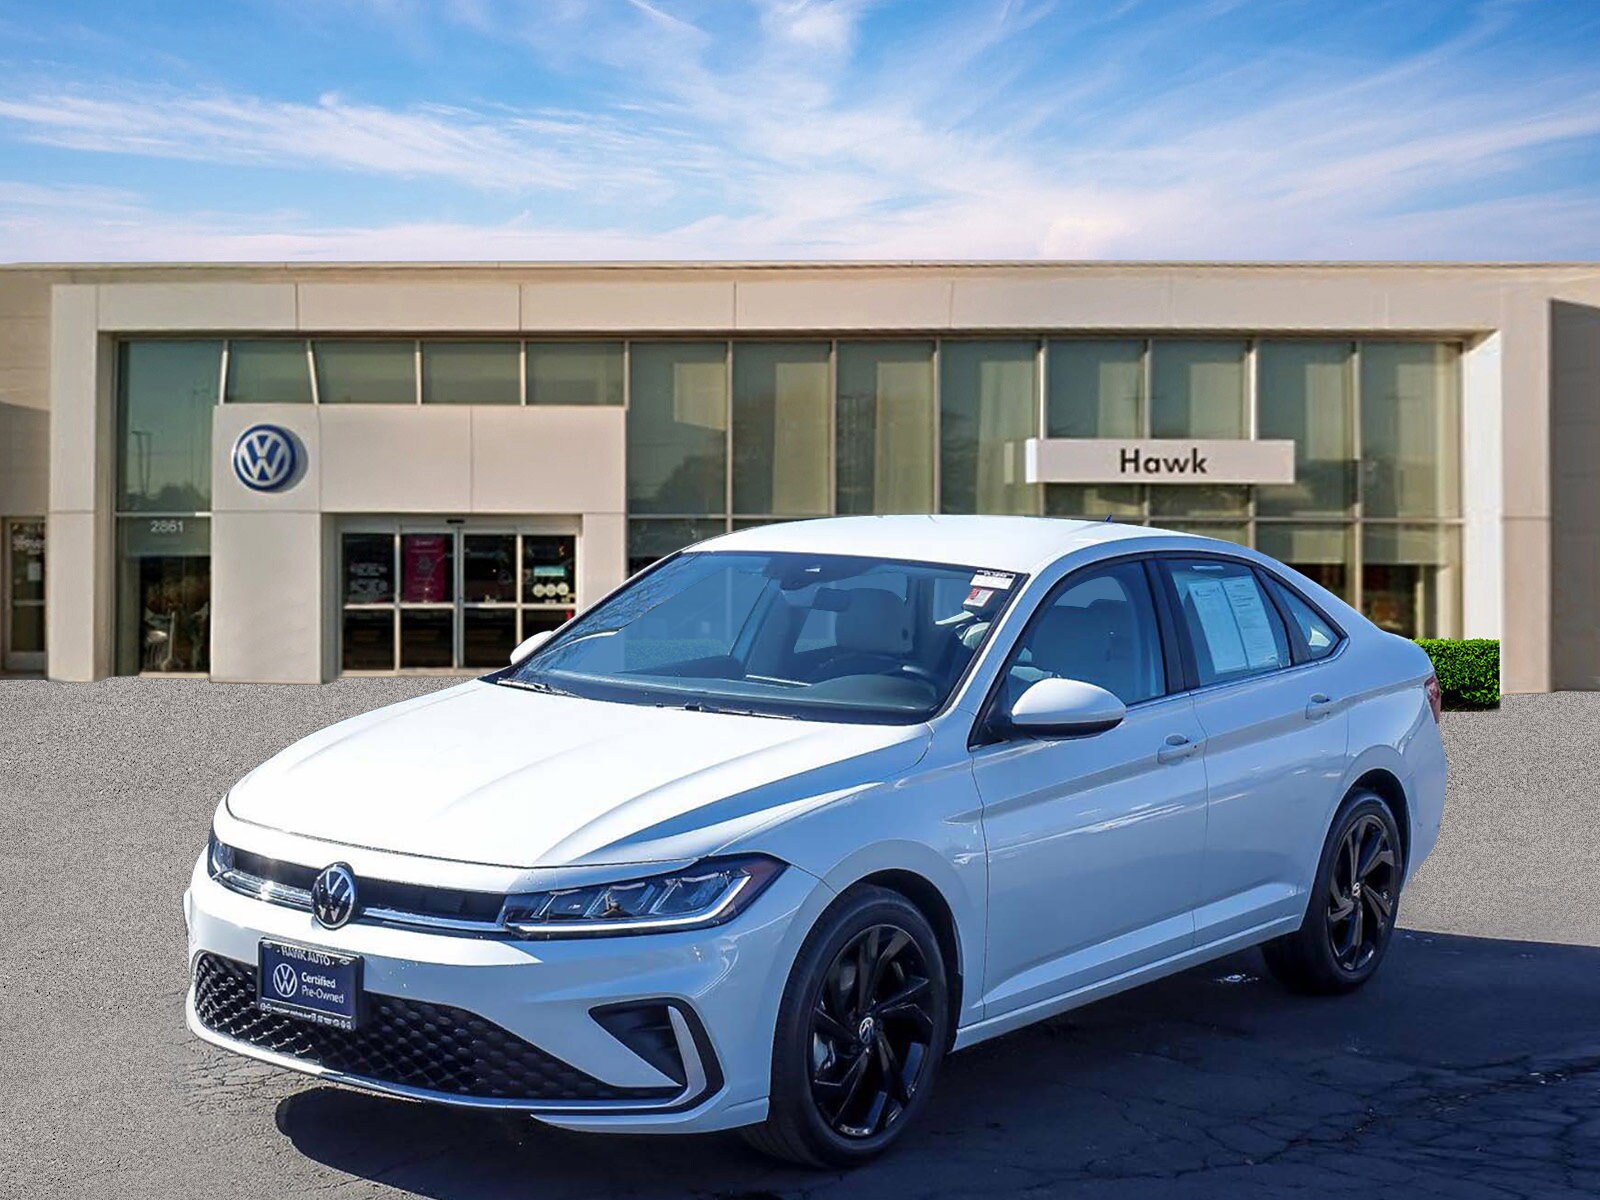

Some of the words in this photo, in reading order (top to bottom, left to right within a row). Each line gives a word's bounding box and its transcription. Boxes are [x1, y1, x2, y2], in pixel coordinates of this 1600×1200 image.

[236, 430, 292, 487] VW
[1120, 447, 1208, 474] Hawk
[150, 520, 184, 533] 2861
[307, 952, 331, 967] AUTO
[301, 972, 336, 989] Certified
[301, 984, 345, 1004] Pre-Owned
